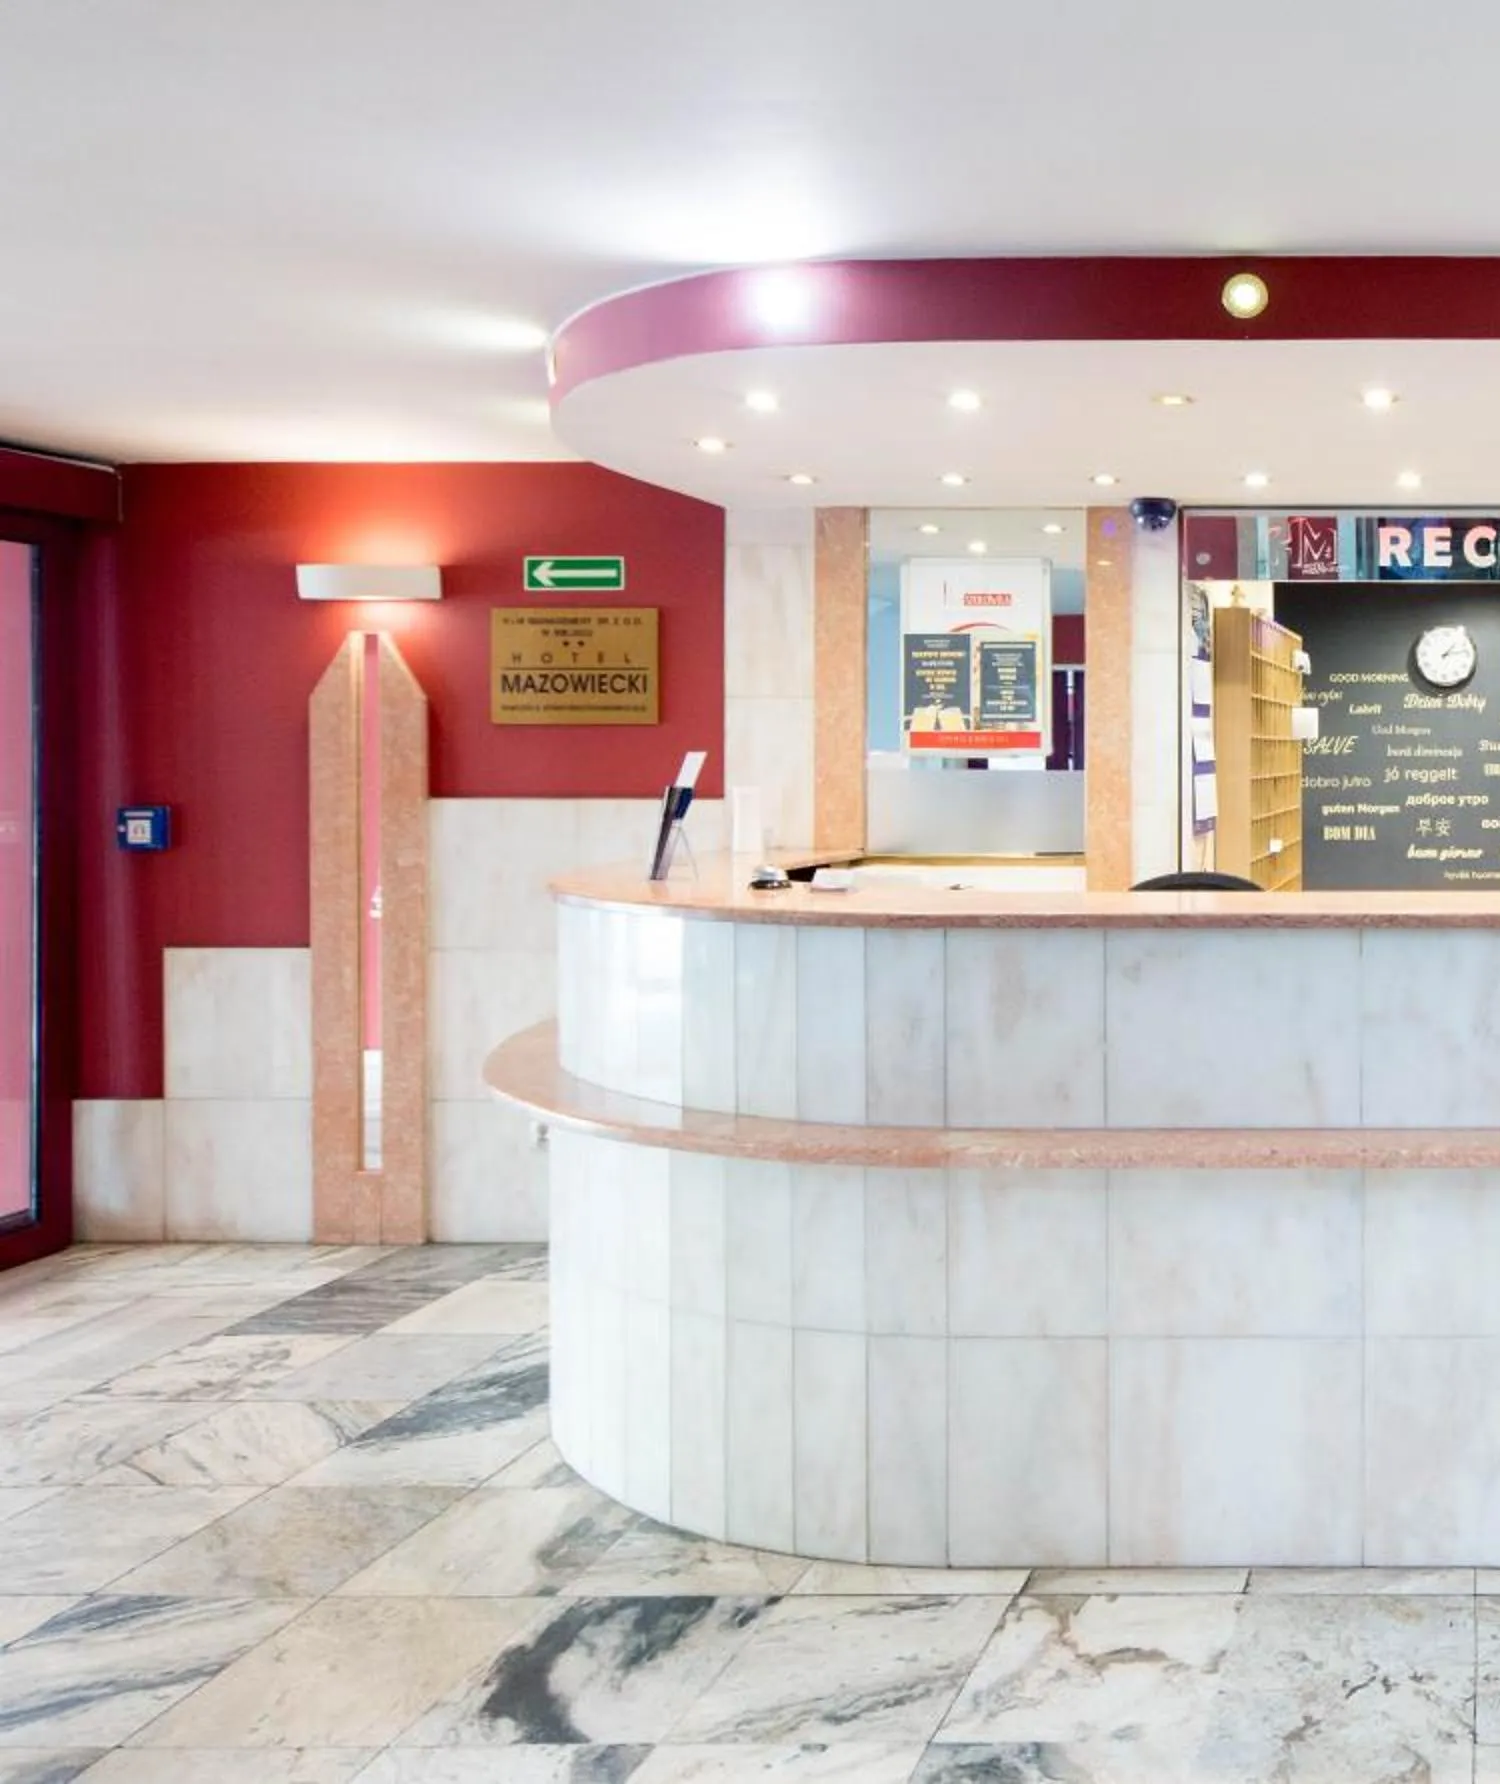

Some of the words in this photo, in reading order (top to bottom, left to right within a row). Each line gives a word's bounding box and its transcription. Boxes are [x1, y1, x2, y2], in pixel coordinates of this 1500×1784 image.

[501, 673, 648, 694] MAZOWIECKI
[1329, 673, 1359, 683] GOOD
[1303, 736, 1359, 755] SALVE
[1405, 793, 1456, 807] доброе
[1457, 795, 1489, 807] утро
[1323, 826, 1351, 841] BOM
[1354, 826, 1377, 841] DIA
[1415, 817, 1452, 838] 早安
